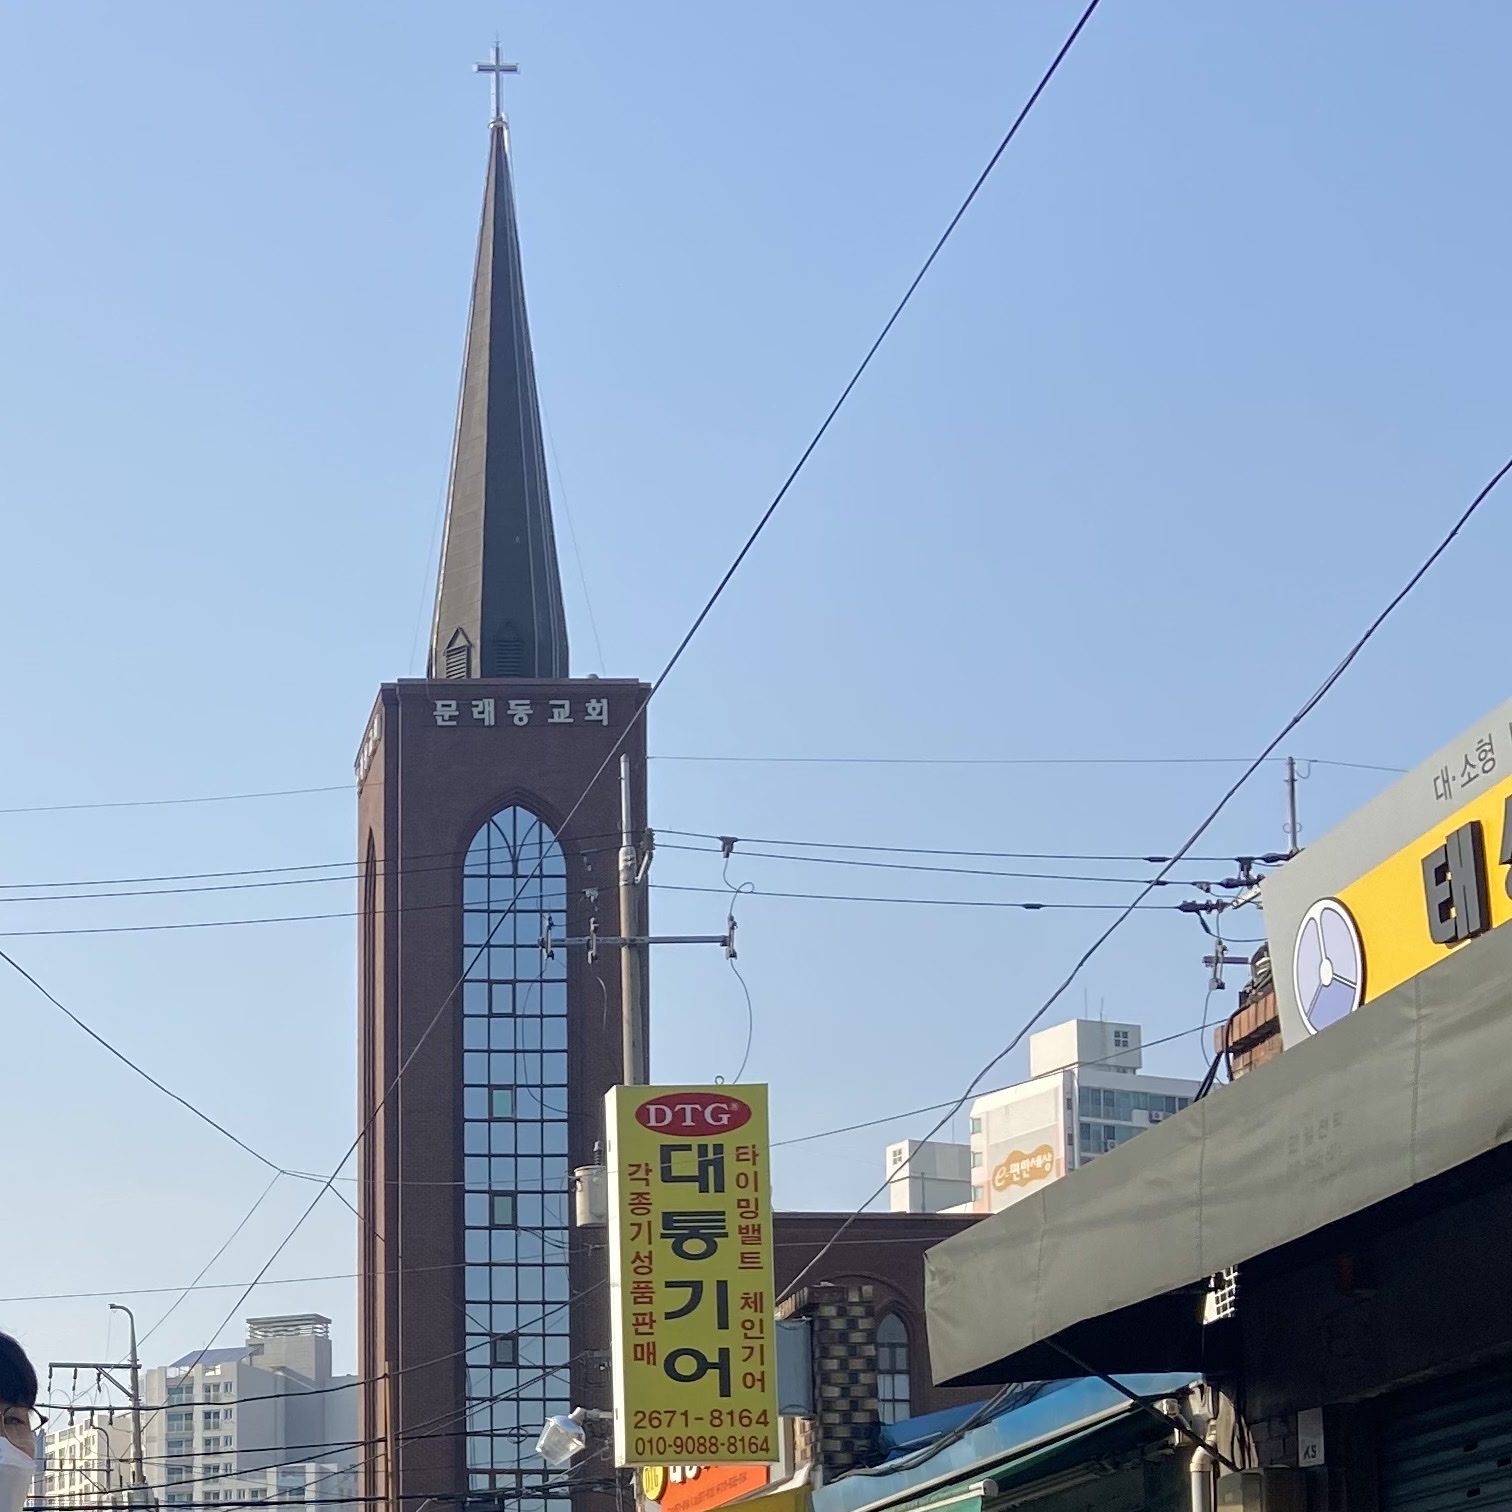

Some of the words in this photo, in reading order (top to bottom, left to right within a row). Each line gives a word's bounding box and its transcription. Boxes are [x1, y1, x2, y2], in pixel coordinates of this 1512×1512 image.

[645, 1103, 732, 1127] DTG
[627, 1163, 657, 1367] 각종기성품판매
[659, 1143, 732, 1398] 대통기어
[740, 1291, 767, 1393] 체인기어
[633, 1409, 770, 1429] 2671-8164
[634, 1435, 770, 1456] 010-9088-8164
